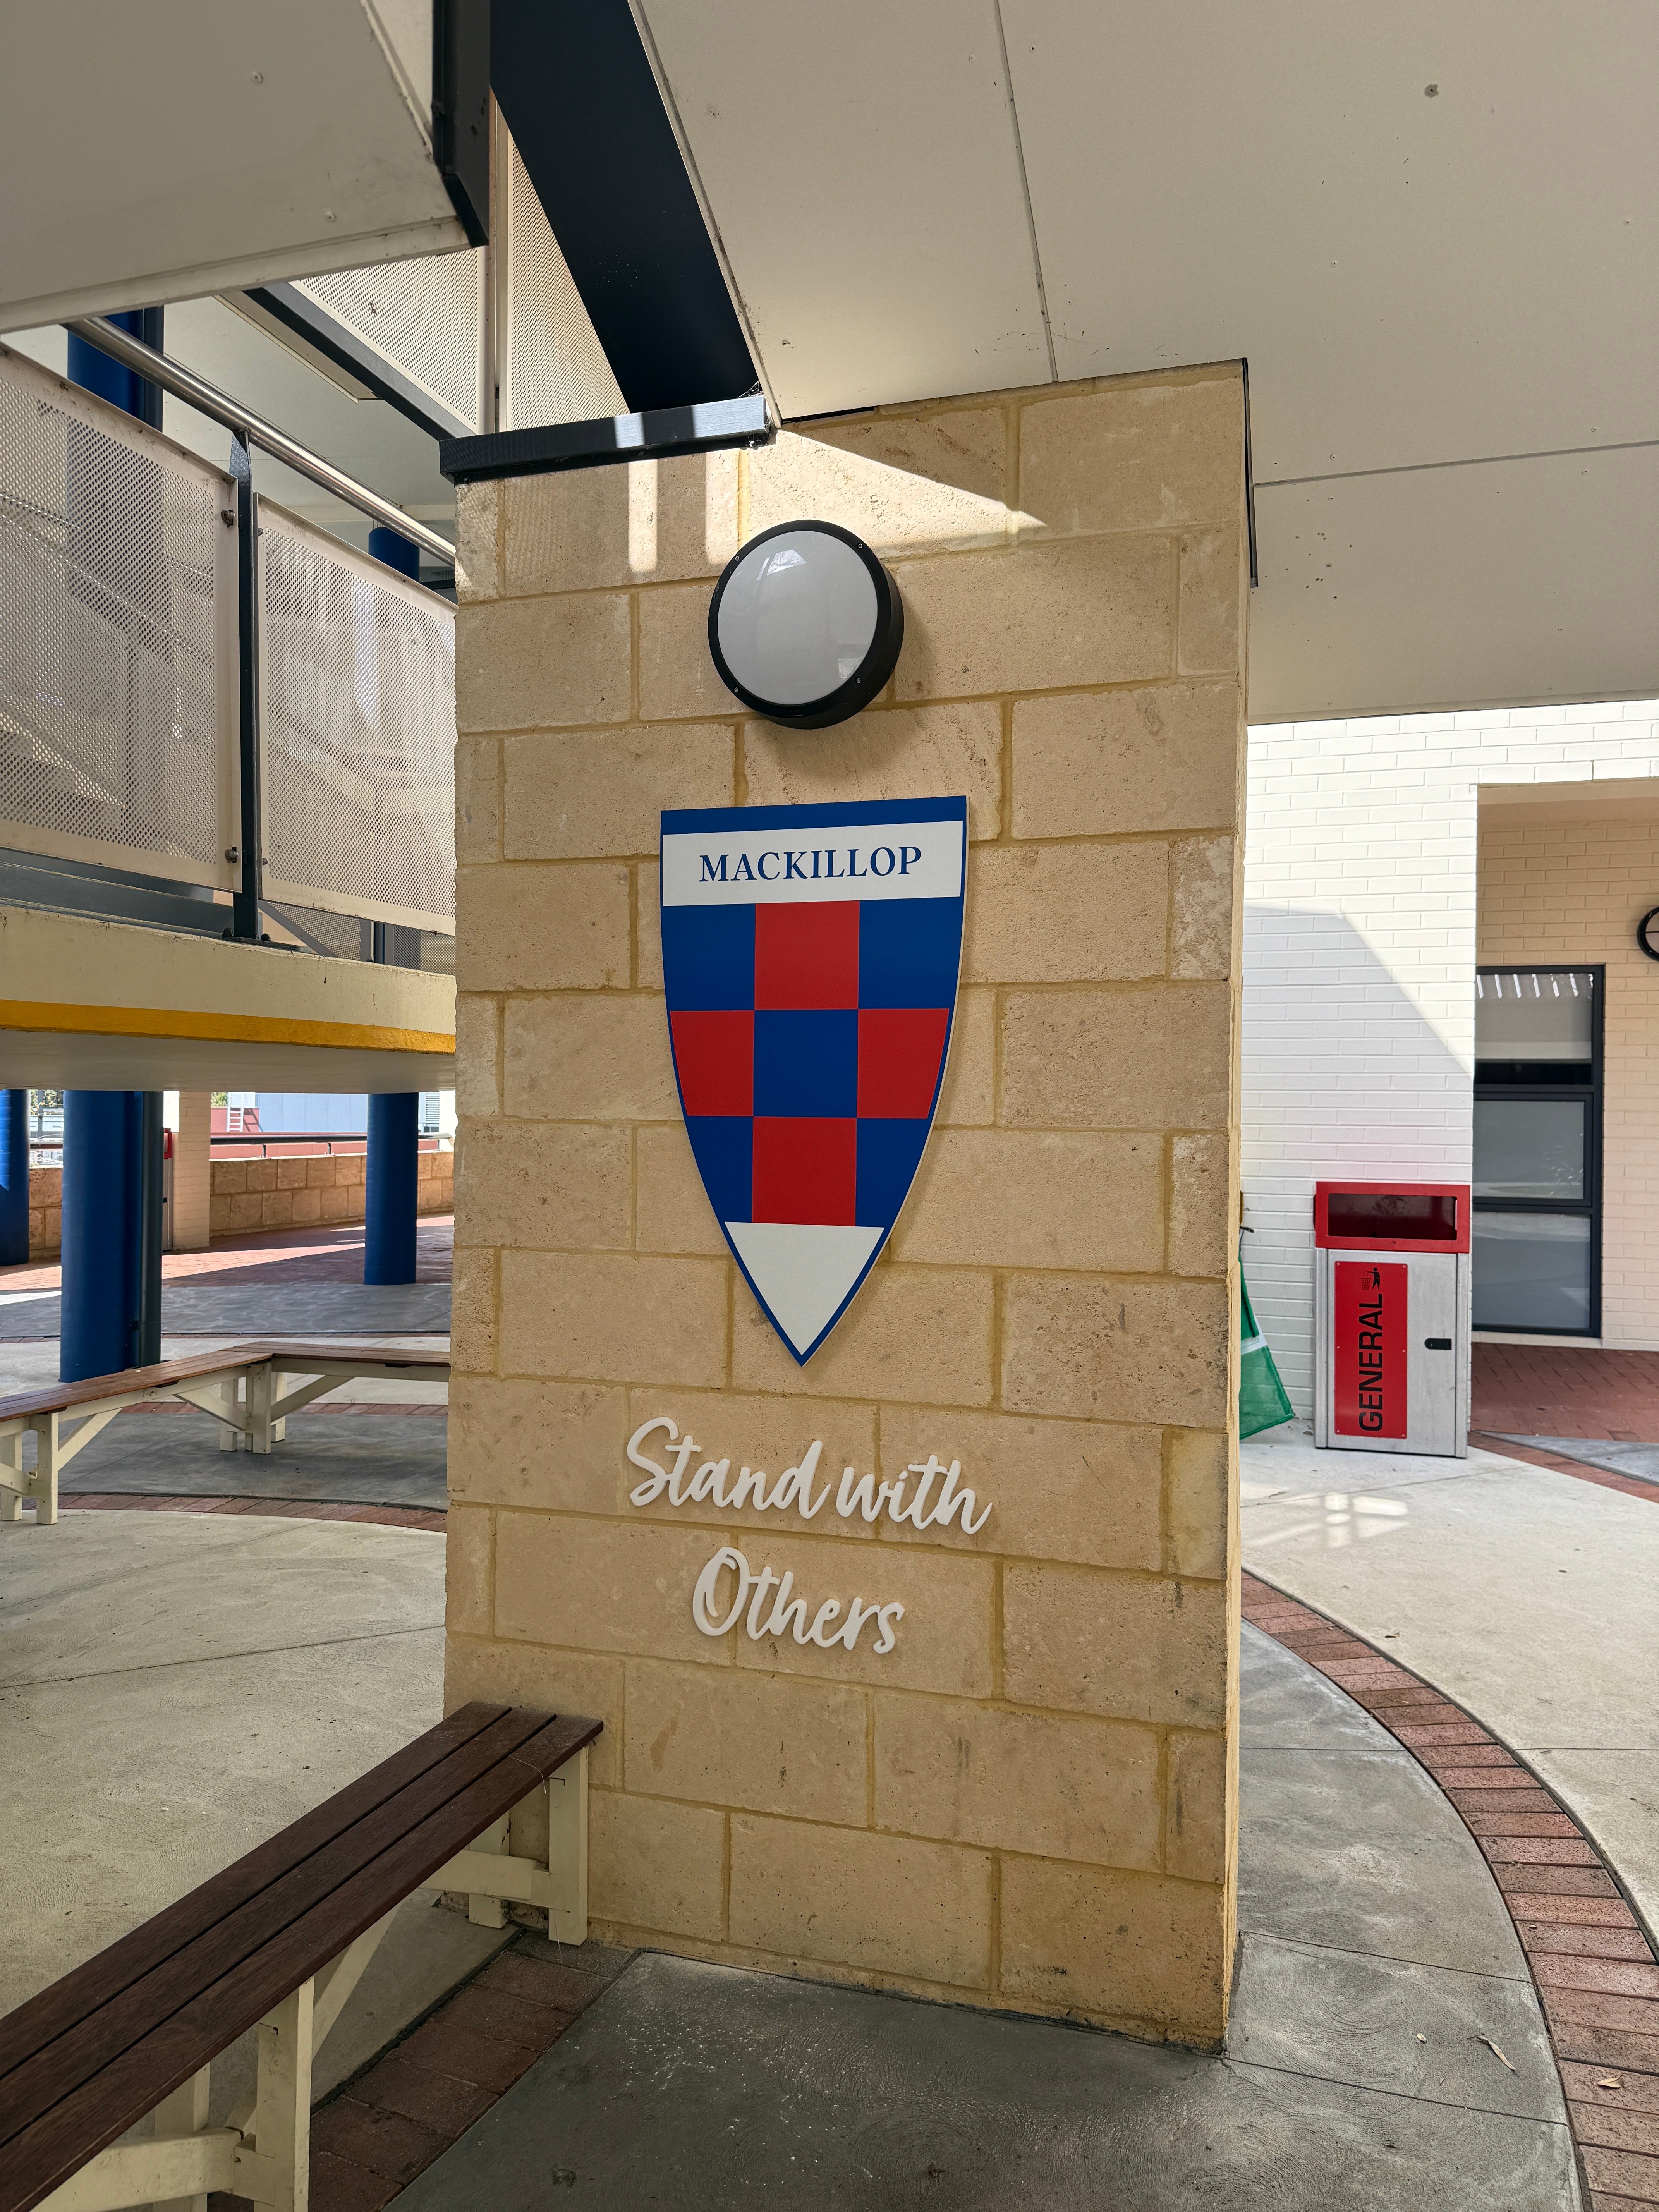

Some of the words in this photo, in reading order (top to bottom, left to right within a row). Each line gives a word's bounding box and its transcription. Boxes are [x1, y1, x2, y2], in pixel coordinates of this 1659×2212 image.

[700, 846, 922, 882] MACKILLOP
[1359, 1293, 1383, 1431] GENERAL
[628, 1417, 830, 1520] Stand
[835, 1455, 992, 1535] with
[692, 1547, 905, 1654] Others
